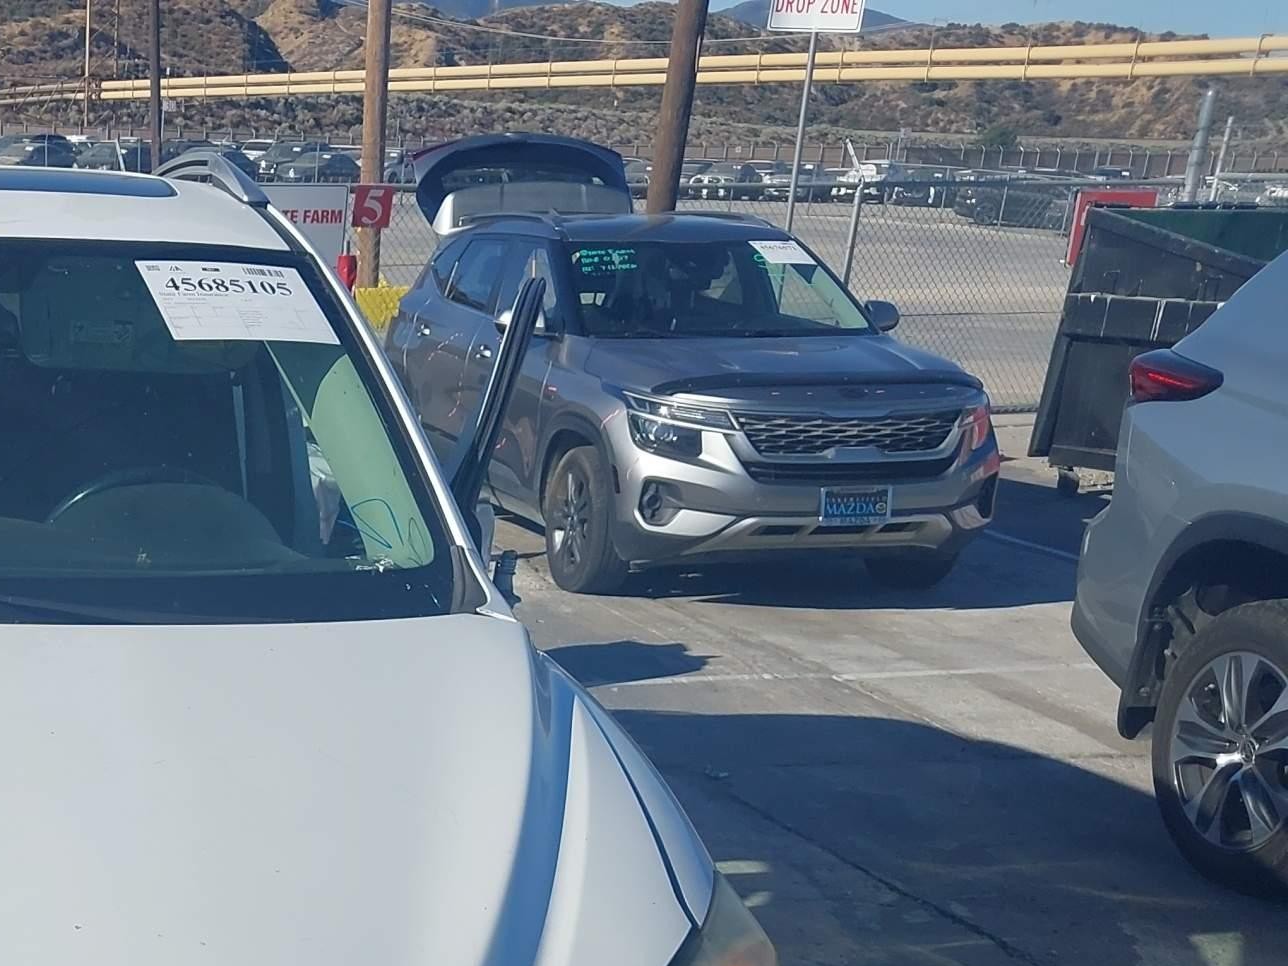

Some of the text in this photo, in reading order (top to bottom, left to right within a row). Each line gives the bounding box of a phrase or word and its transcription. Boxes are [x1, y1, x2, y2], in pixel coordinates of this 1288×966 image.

[775, 0, 858, 14] DROP ZONE
[361, 189, 385, 224] 5
[302, 209, 343, 224] FARM
[165, 277, 293, 296] 45685105
[826, 503, 875, 515] MAZDA
